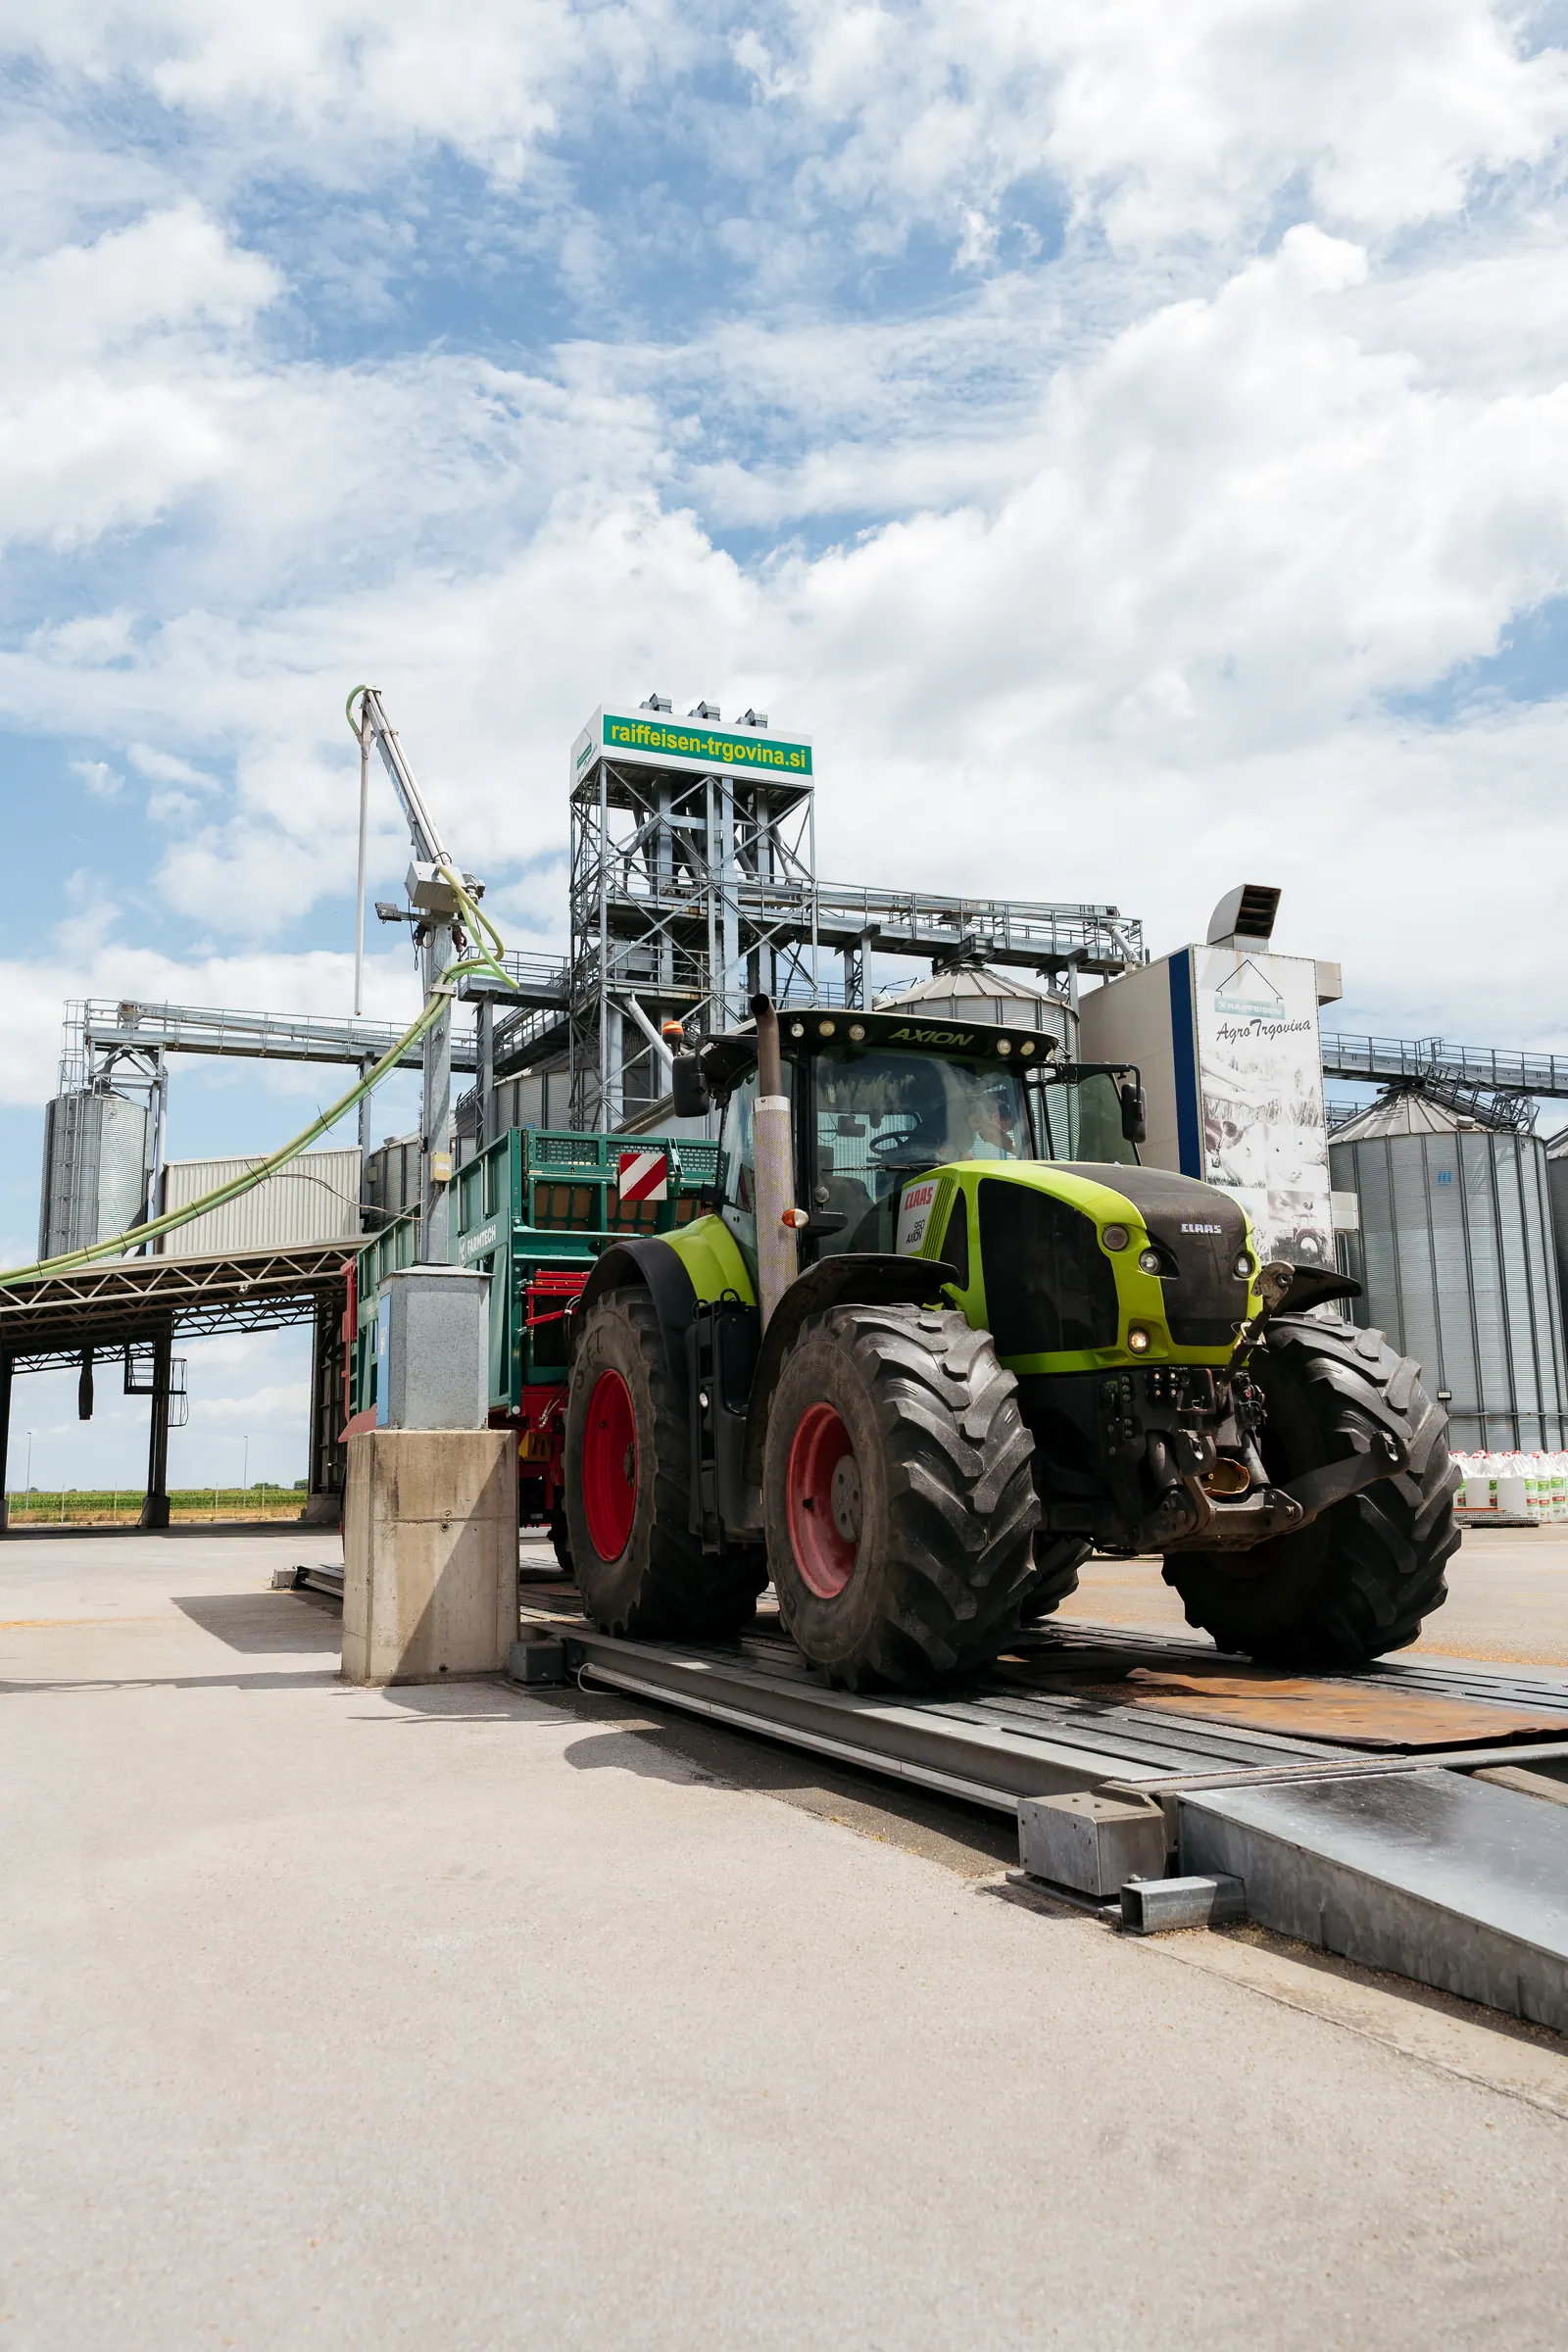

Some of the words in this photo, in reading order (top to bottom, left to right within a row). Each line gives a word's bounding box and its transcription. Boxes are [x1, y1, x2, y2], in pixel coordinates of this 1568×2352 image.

[611, 723, 806, 768] raiffeisen-trgovina.si
[1227, 1003, 1283, 1016] RAIFFEISEN
[888, 1028, 974, 1046] AXION
[1216, 1022, 1251, 1045] Agro
[1250, 1018, 1312, 1042] Trgovina
[904, 1186, 934, 1211] CLAAS
[906, 1230, 922, 1245] AXION
[1181, 1223, 1223, 1235] CLAAS
[466, 1224, 497, 1258] FARMTECH
